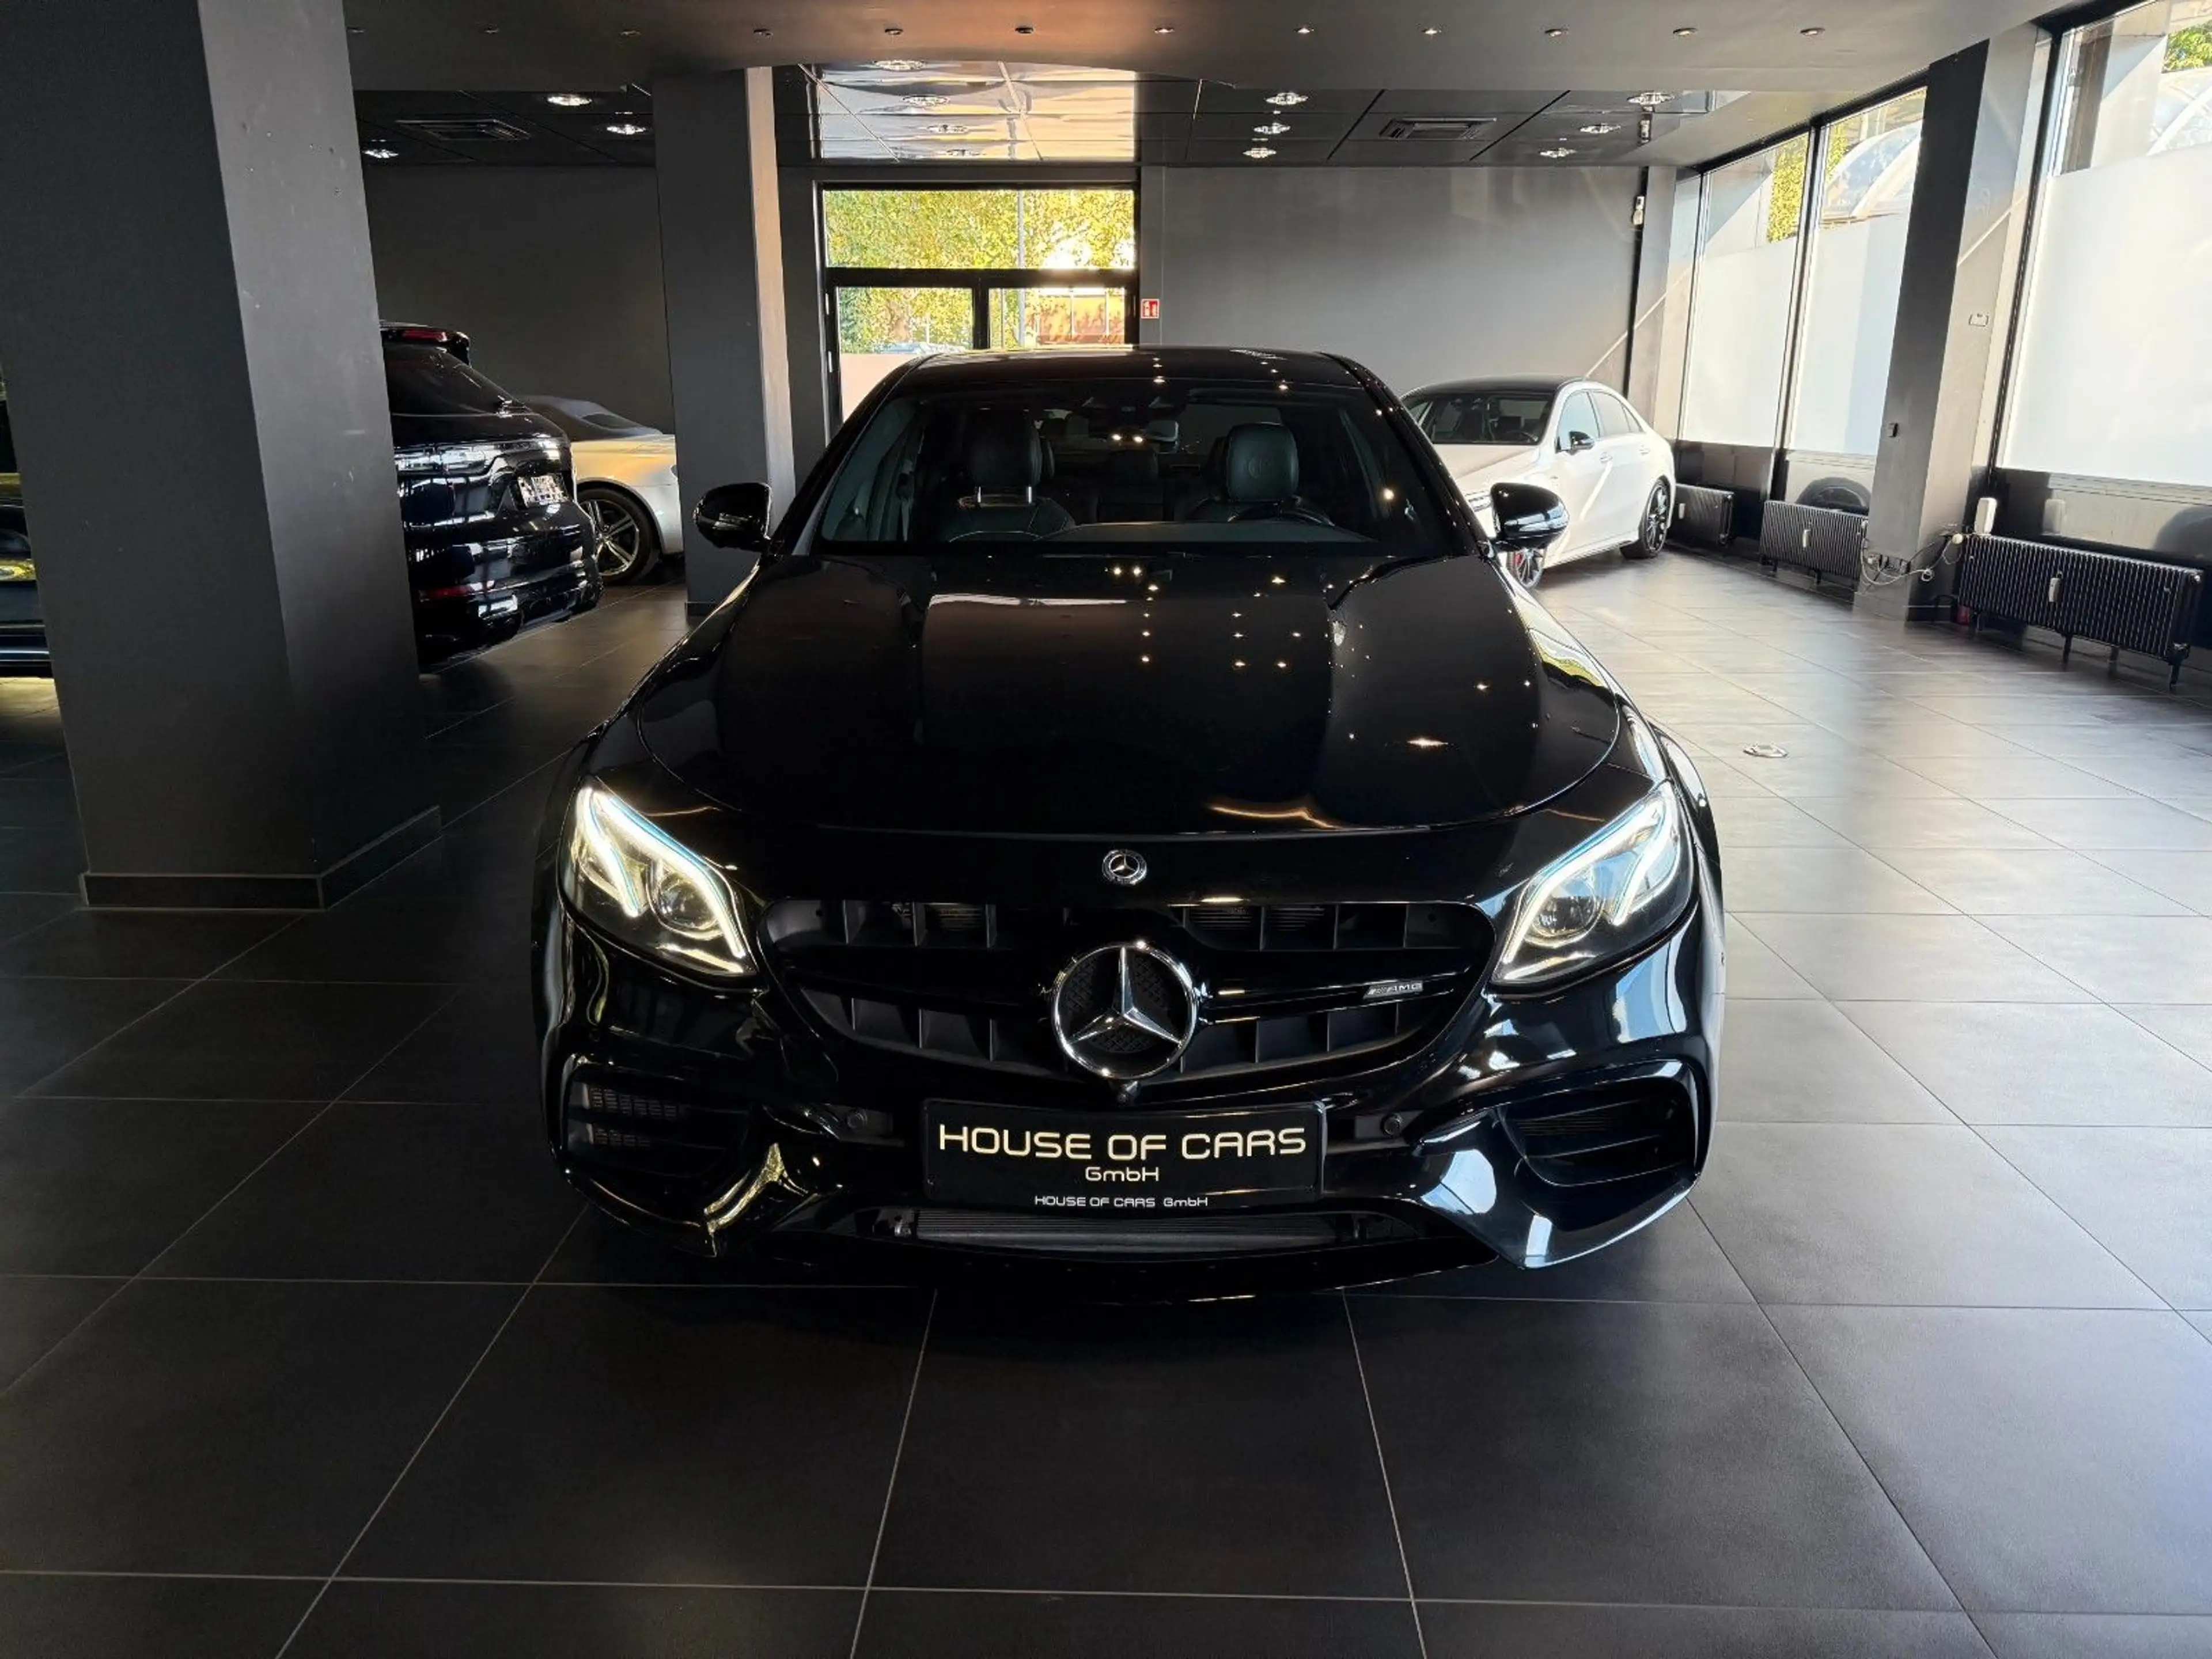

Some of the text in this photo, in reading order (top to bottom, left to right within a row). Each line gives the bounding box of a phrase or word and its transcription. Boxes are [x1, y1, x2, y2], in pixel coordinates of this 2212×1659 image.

[1385, 982, 1423, 993] AMG
[940, 1124, 1306, 1161] HOUSE OF CARS
[1085, 1166, 1160, 1182] GmbH
[1035, 1195, 1209, 1208] HOUSE OF CARS GmbH
